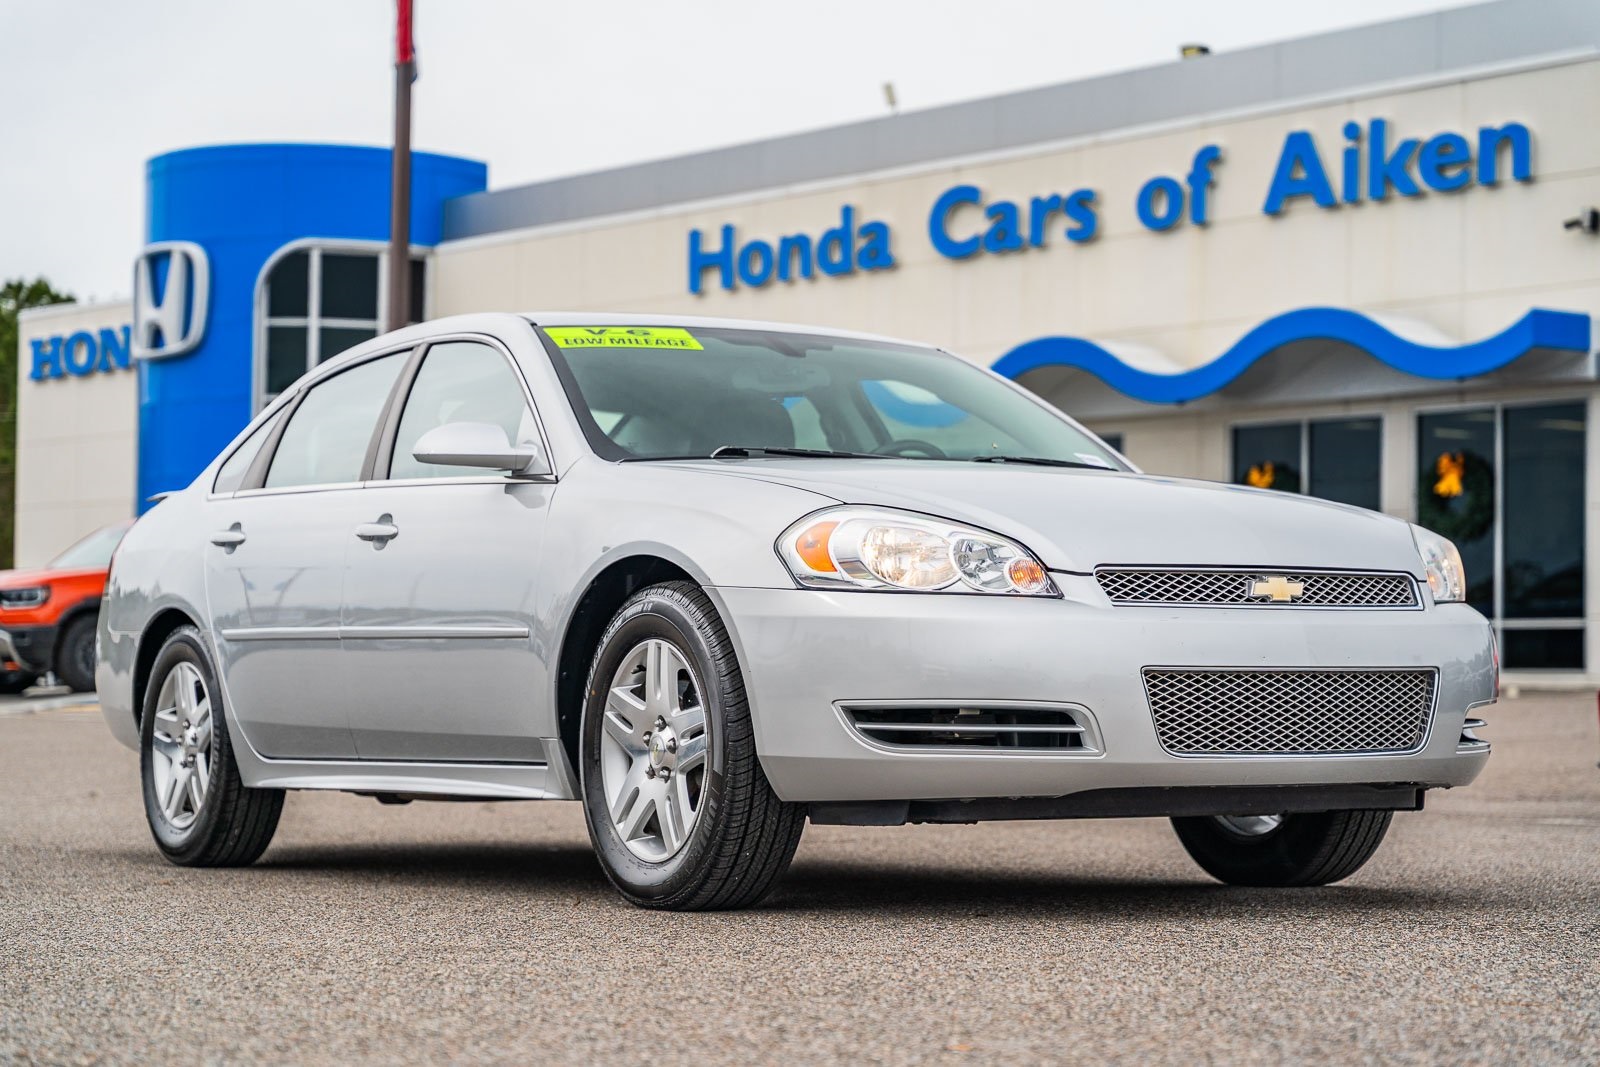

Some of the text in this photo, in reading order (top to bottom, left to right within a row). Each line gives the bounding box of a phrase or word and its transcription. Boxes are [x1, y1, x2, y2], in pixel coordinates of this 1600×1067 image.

[688, 118, 1532, 294] Honda Cars of Aiken
[563, 338, 689, 348] LOW MILEAGE
